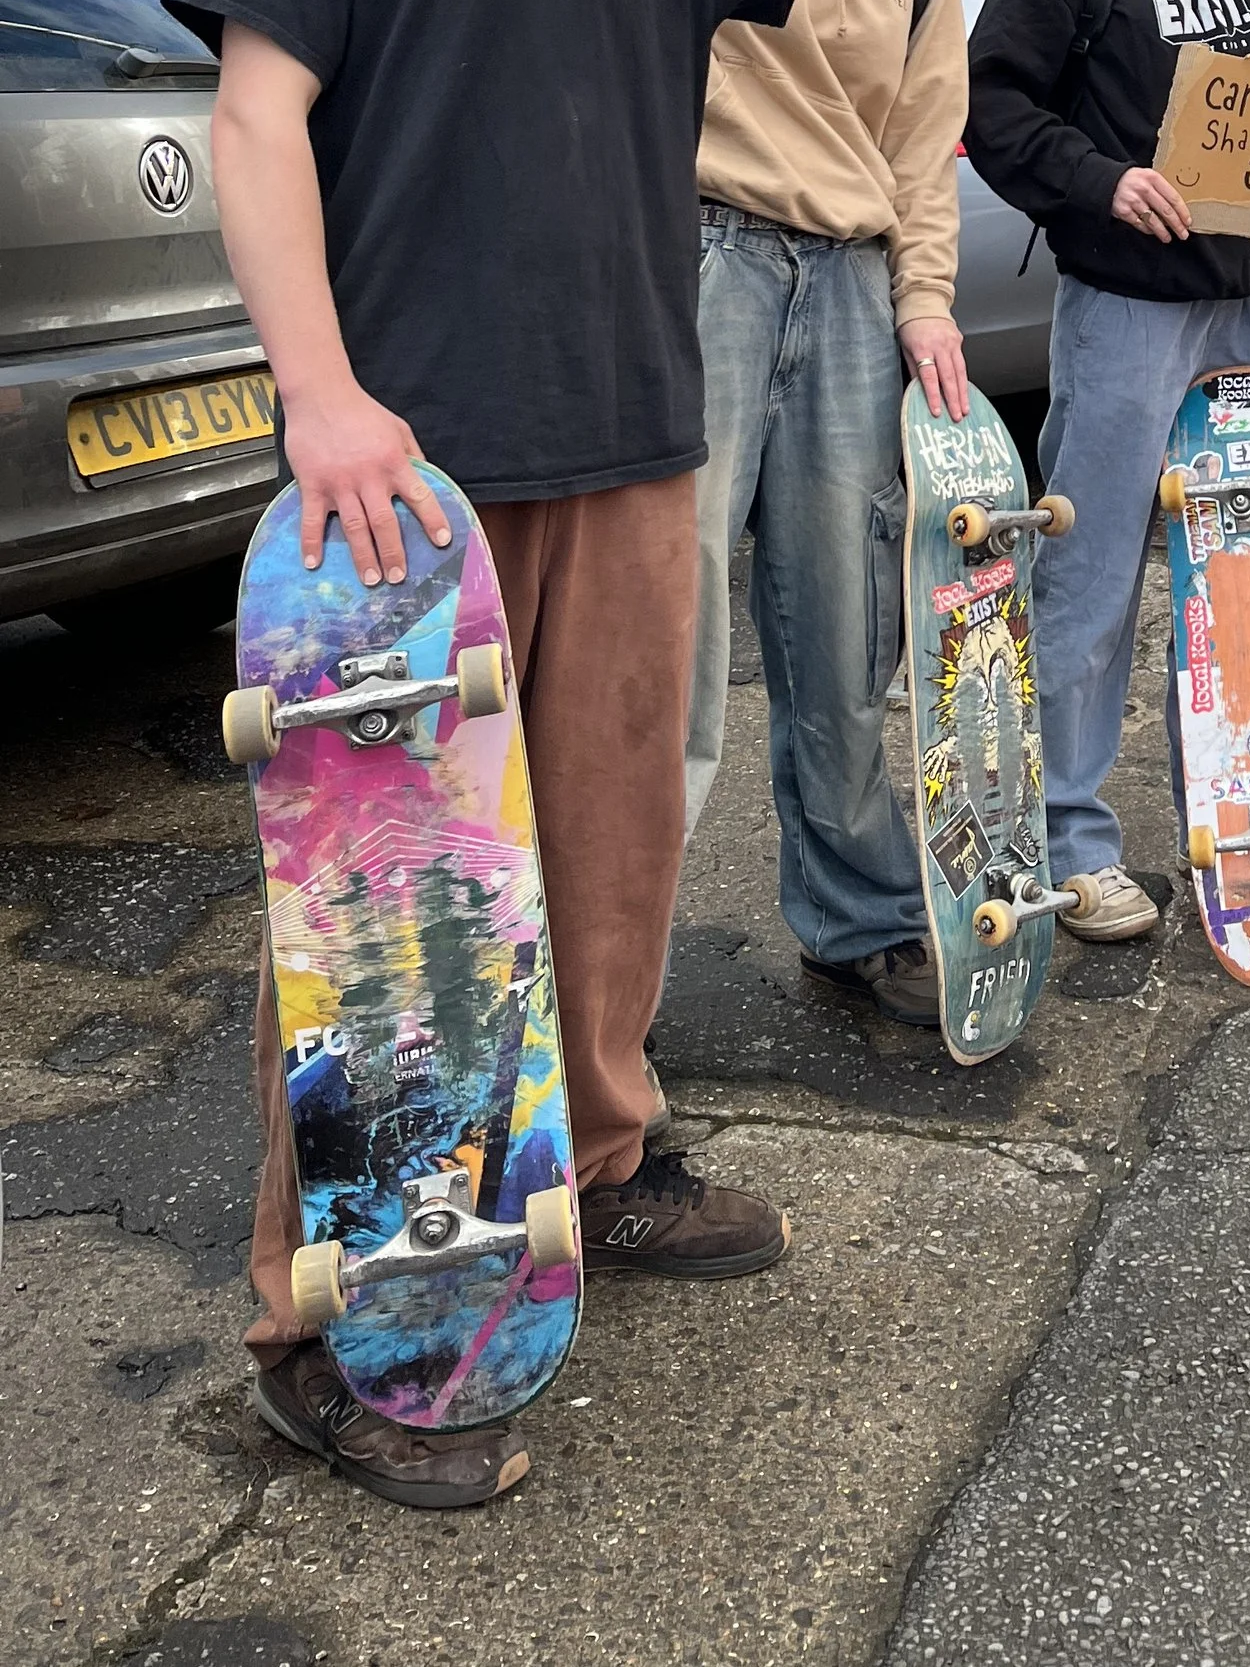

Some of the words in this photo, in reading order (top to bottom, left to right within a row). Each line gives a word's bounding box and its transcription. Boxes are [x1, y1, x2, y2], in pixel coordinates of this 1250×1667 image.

[93, 391, 200, 457] CV13
[914, 421, 1013, 471] HEROIN
[1199, 501, 1222, 548] SAM
[605, 1215, 654, 1248] N
